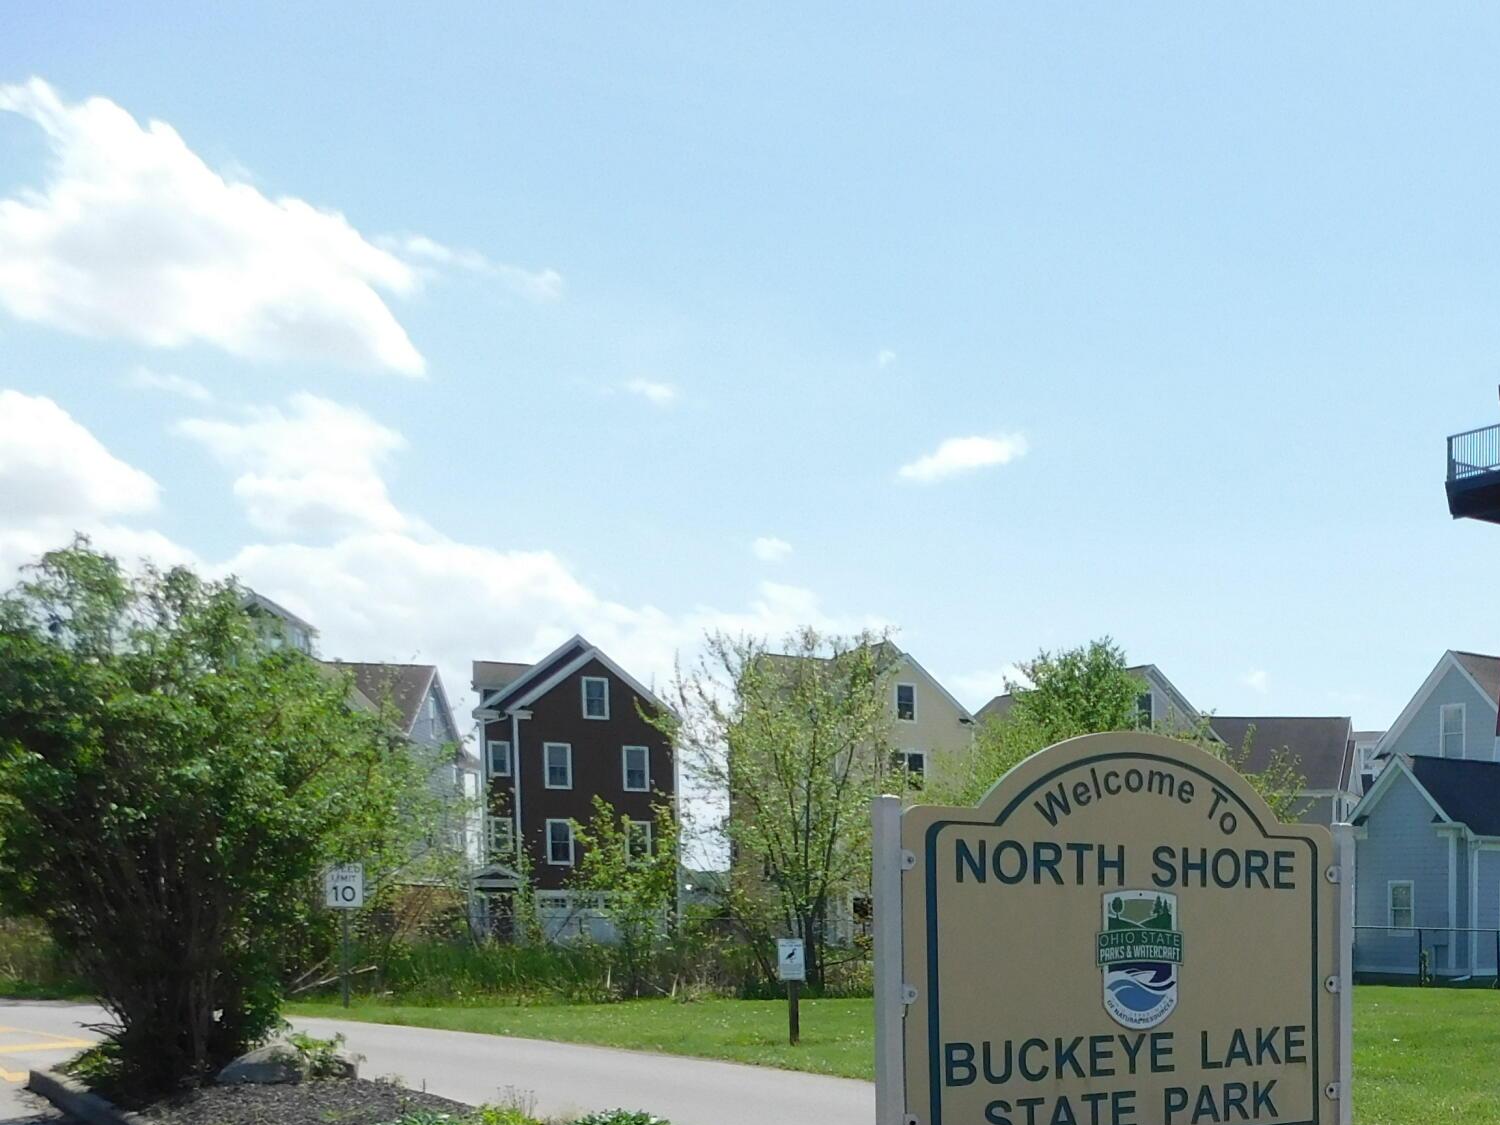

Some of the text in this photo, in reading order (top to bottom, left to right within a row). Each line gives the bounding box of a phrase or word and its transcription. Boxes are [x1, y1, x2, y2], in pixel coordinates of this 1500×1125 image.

[1033, 767, 1237, 835] Welcome To
[955, 839, 1296, 889] NORTH SHORE
[332, 885, 356, 902] 10
[1099, 931, 1180, 947] OHIO STATE
[1100, 945, 1180, 962] PARKS & WATERCRAFT
[945, 1025, 1307, 1088] BUCKEYE LAKE
